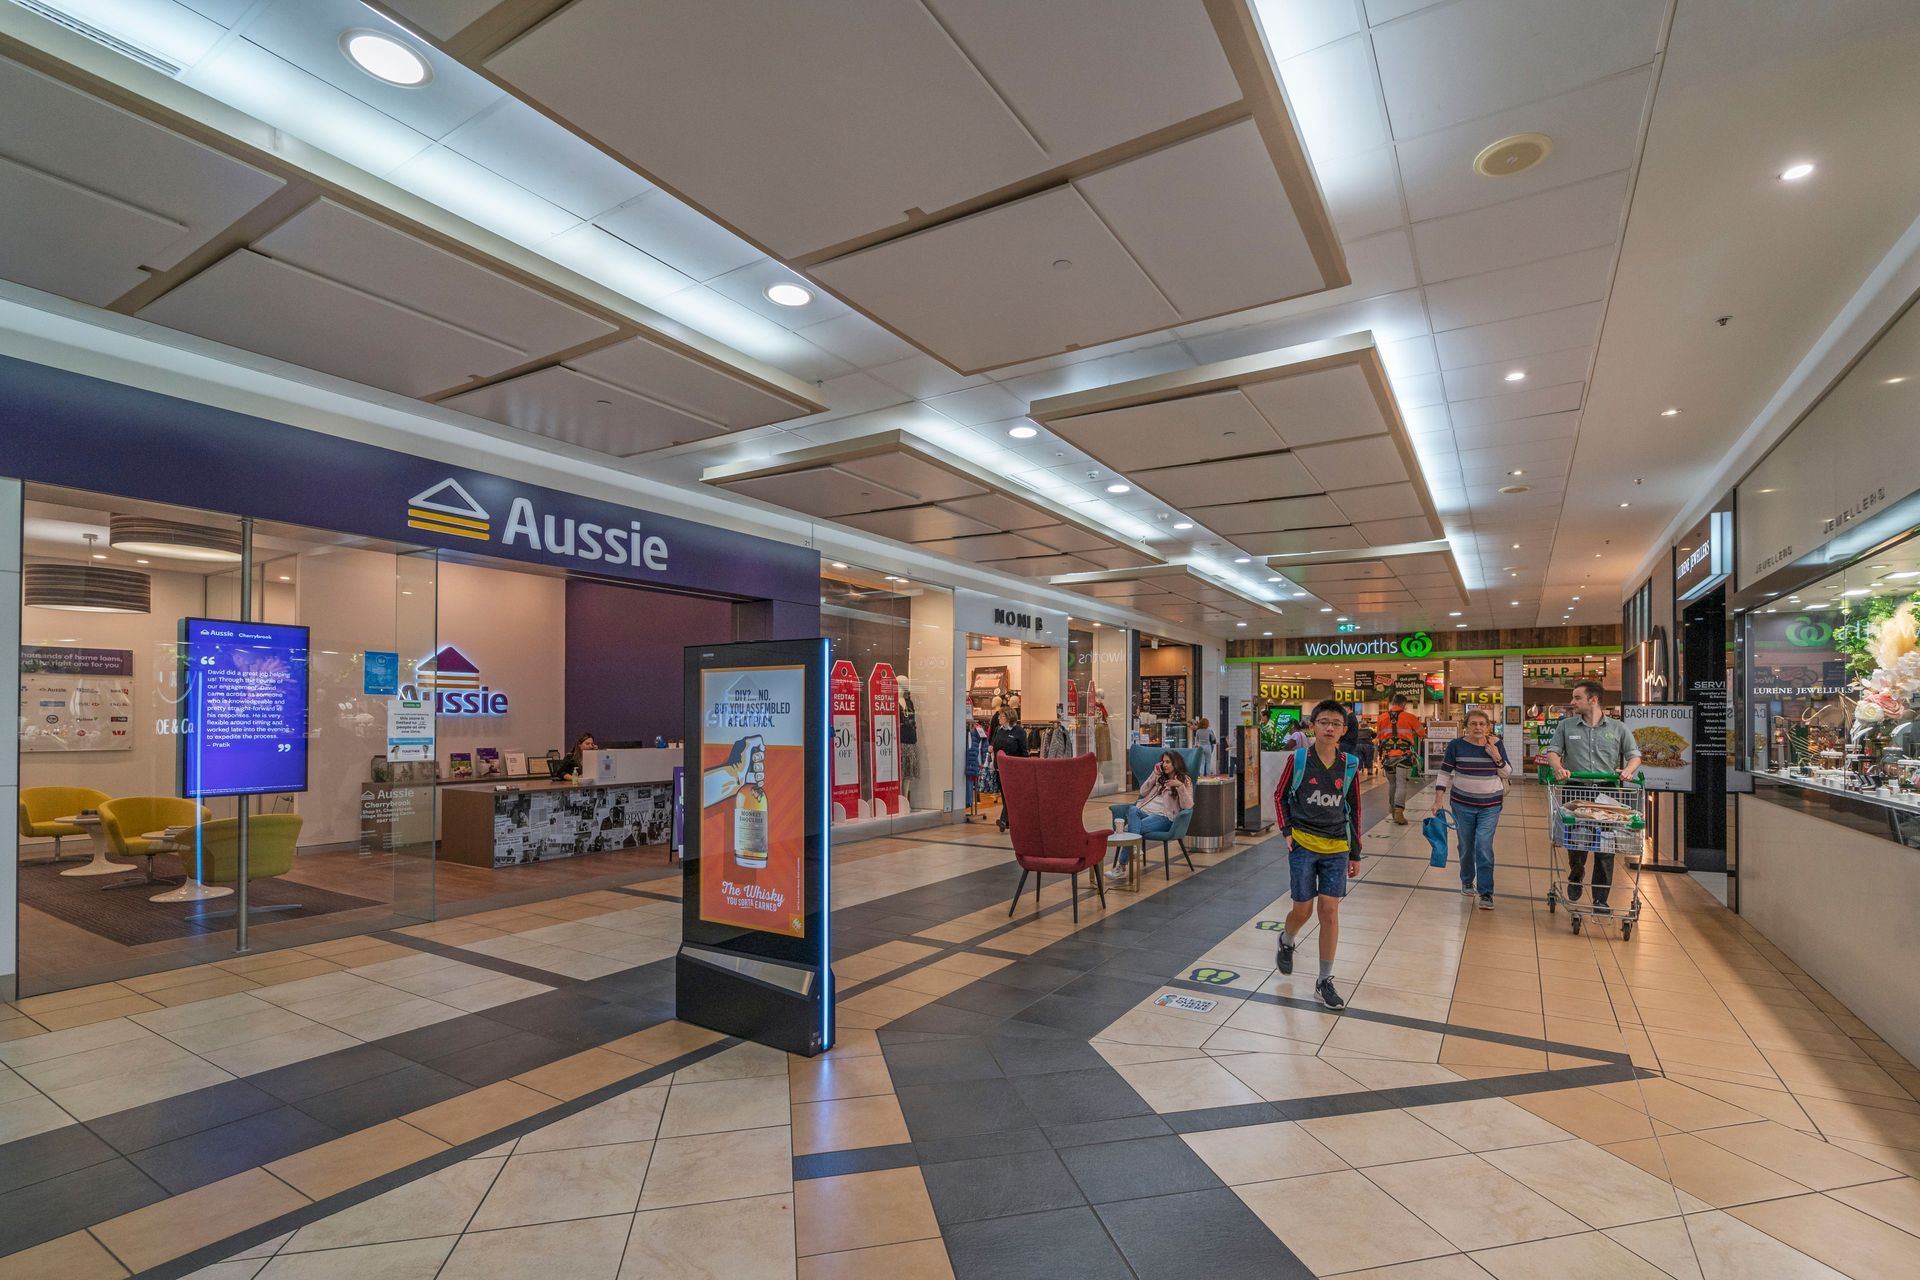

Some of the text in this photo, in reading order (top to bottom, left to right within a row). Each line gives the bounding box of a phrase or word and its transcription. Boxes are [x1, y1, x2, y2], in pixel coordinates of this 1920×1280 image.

[1823, 487, 1886, 534] JEWELLERS
[502, 497, 668, 571] Aussie
[1755, 546, 1793, 575] JEWELLERS
[995, 608, 1043, 631] NONI B
[1527, 667, 1569, 677] HELP
[1694, 681, 1726, 689] SERVI
[1260, 684, 1305, 699] SUSHI
[1335, 690, 1365, 702] DELI
[1753, 687, 1793, 695] LURENE
[1457, 692, 1504, 704] FISH
[730, 703, 744, 714] YOU
[746, 702, 790, 714] ASSEMBLED
[834, 701, 856, 711] SALE
[874, 702, 895, 711] SALE
[1625, 708, 1649, 719] CASH
[1651, 708, 1668, 719] FOR
[734, 716, 752, 727] FLAT
[839, 750, 851, 758] OFF
[378, 788, 414, 799] Aussie
[364, 800, 410, 809] Cherrybrook
[722, 881, 784, 908] The Whisky
[727, 896, 737, 906] YOU
[755, 900, 777, 912] EARNED
